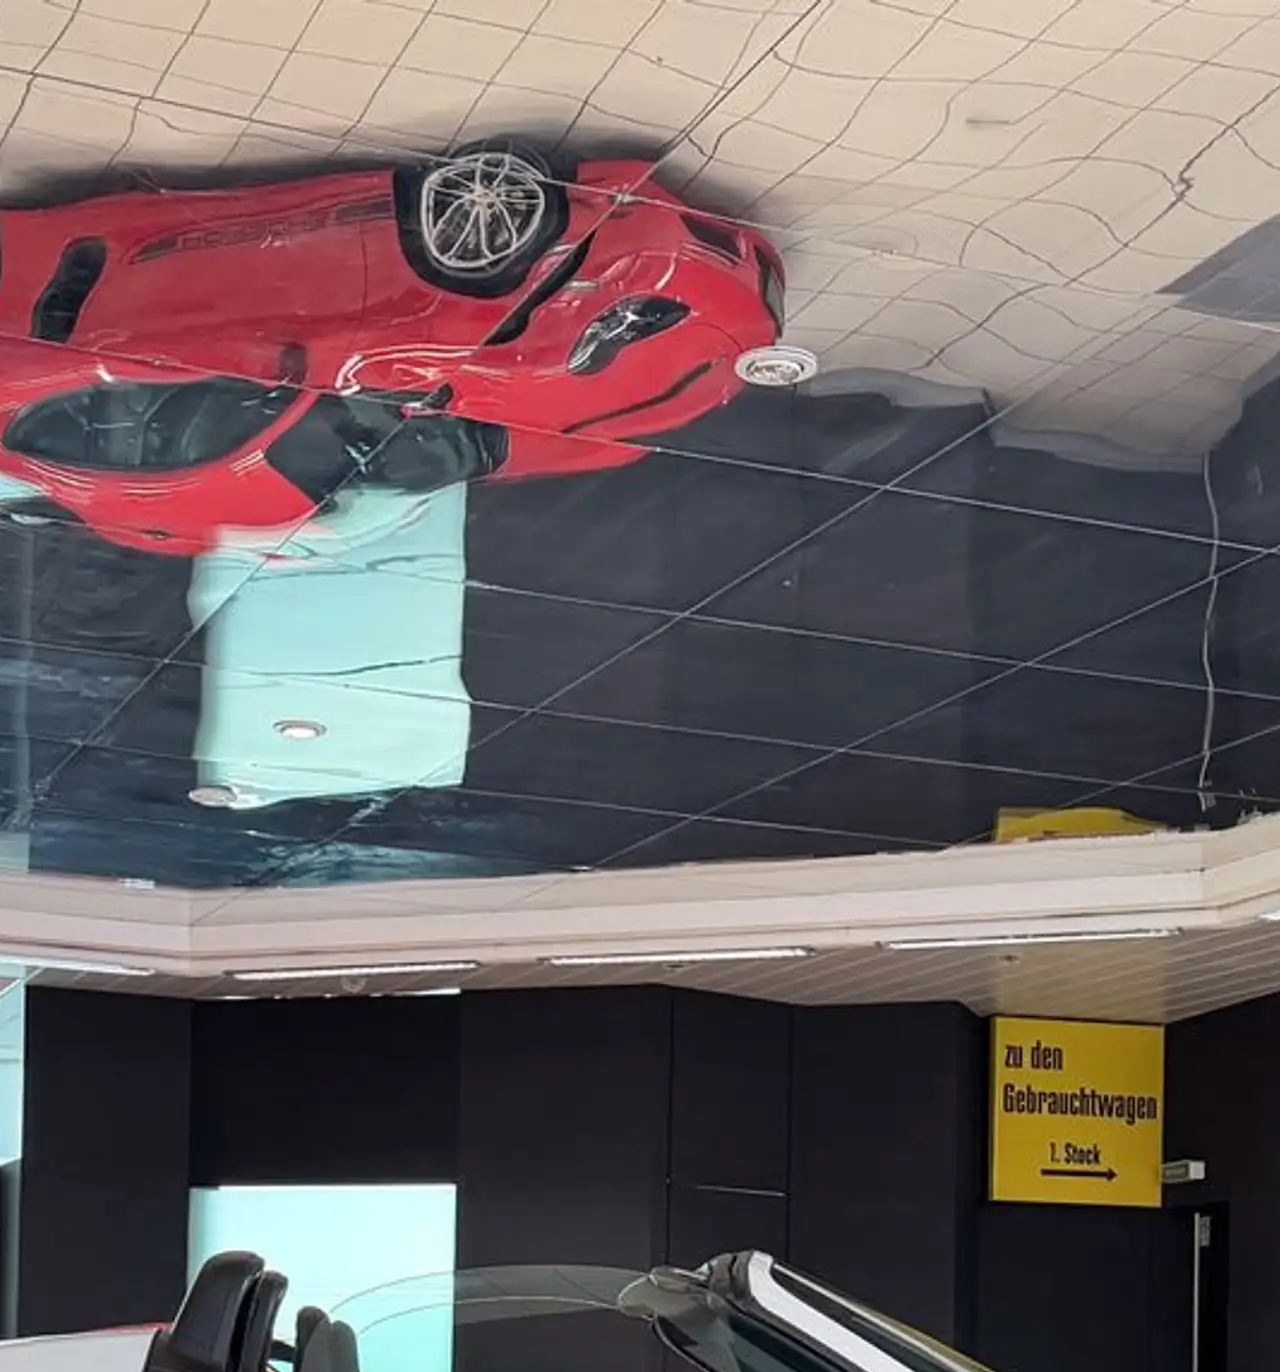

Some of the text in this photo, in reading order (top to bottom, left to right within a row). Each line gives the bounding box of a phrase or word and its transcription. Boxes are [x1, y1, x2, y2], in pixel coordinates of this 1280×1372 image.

[1004, 1040, 1064, 1071] zu den
[1002, 1082, 1158, 1126] Gebrauchtwagen
[1049, 1141, 1102, 1165] 1. Stock
